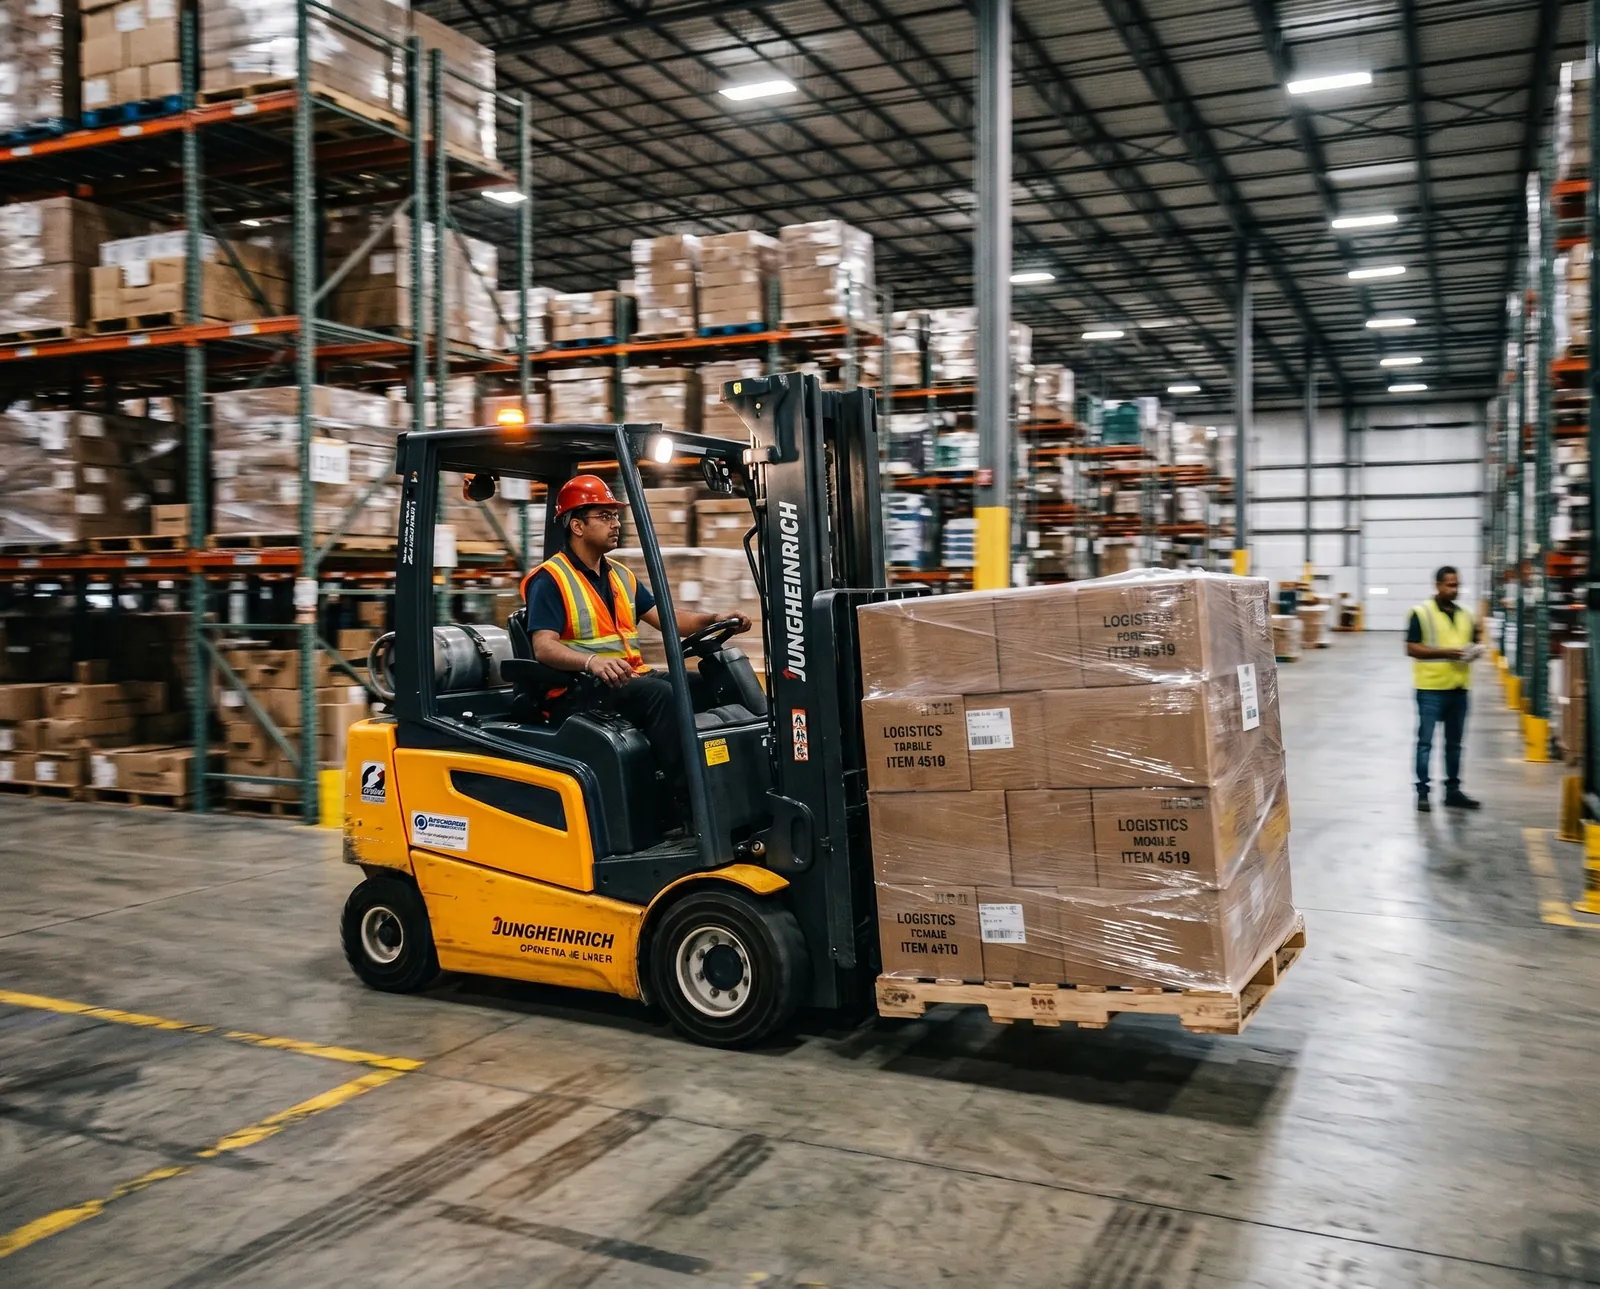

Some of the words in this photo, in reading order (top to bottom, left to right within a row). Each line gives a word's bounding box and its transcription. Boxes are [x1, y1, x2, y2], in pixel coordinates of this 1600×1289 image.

[779, 501, 806, 682] JUNGHEINRICH
[883, 725, 943, 738] LOGISTICS
[887, 756, 914, 768] ITEM
[1118, 818, 1188, 832] LOGISTICS
[1121, 851, 1154, 863] ITEM
[1157, 851, 1191, 864] 4519
[897, 912, 956, 926] LOGISTICS
[492, 916, 614, 949] JUNGHEINRICH
[901, 942, 928, 953] ITEM
